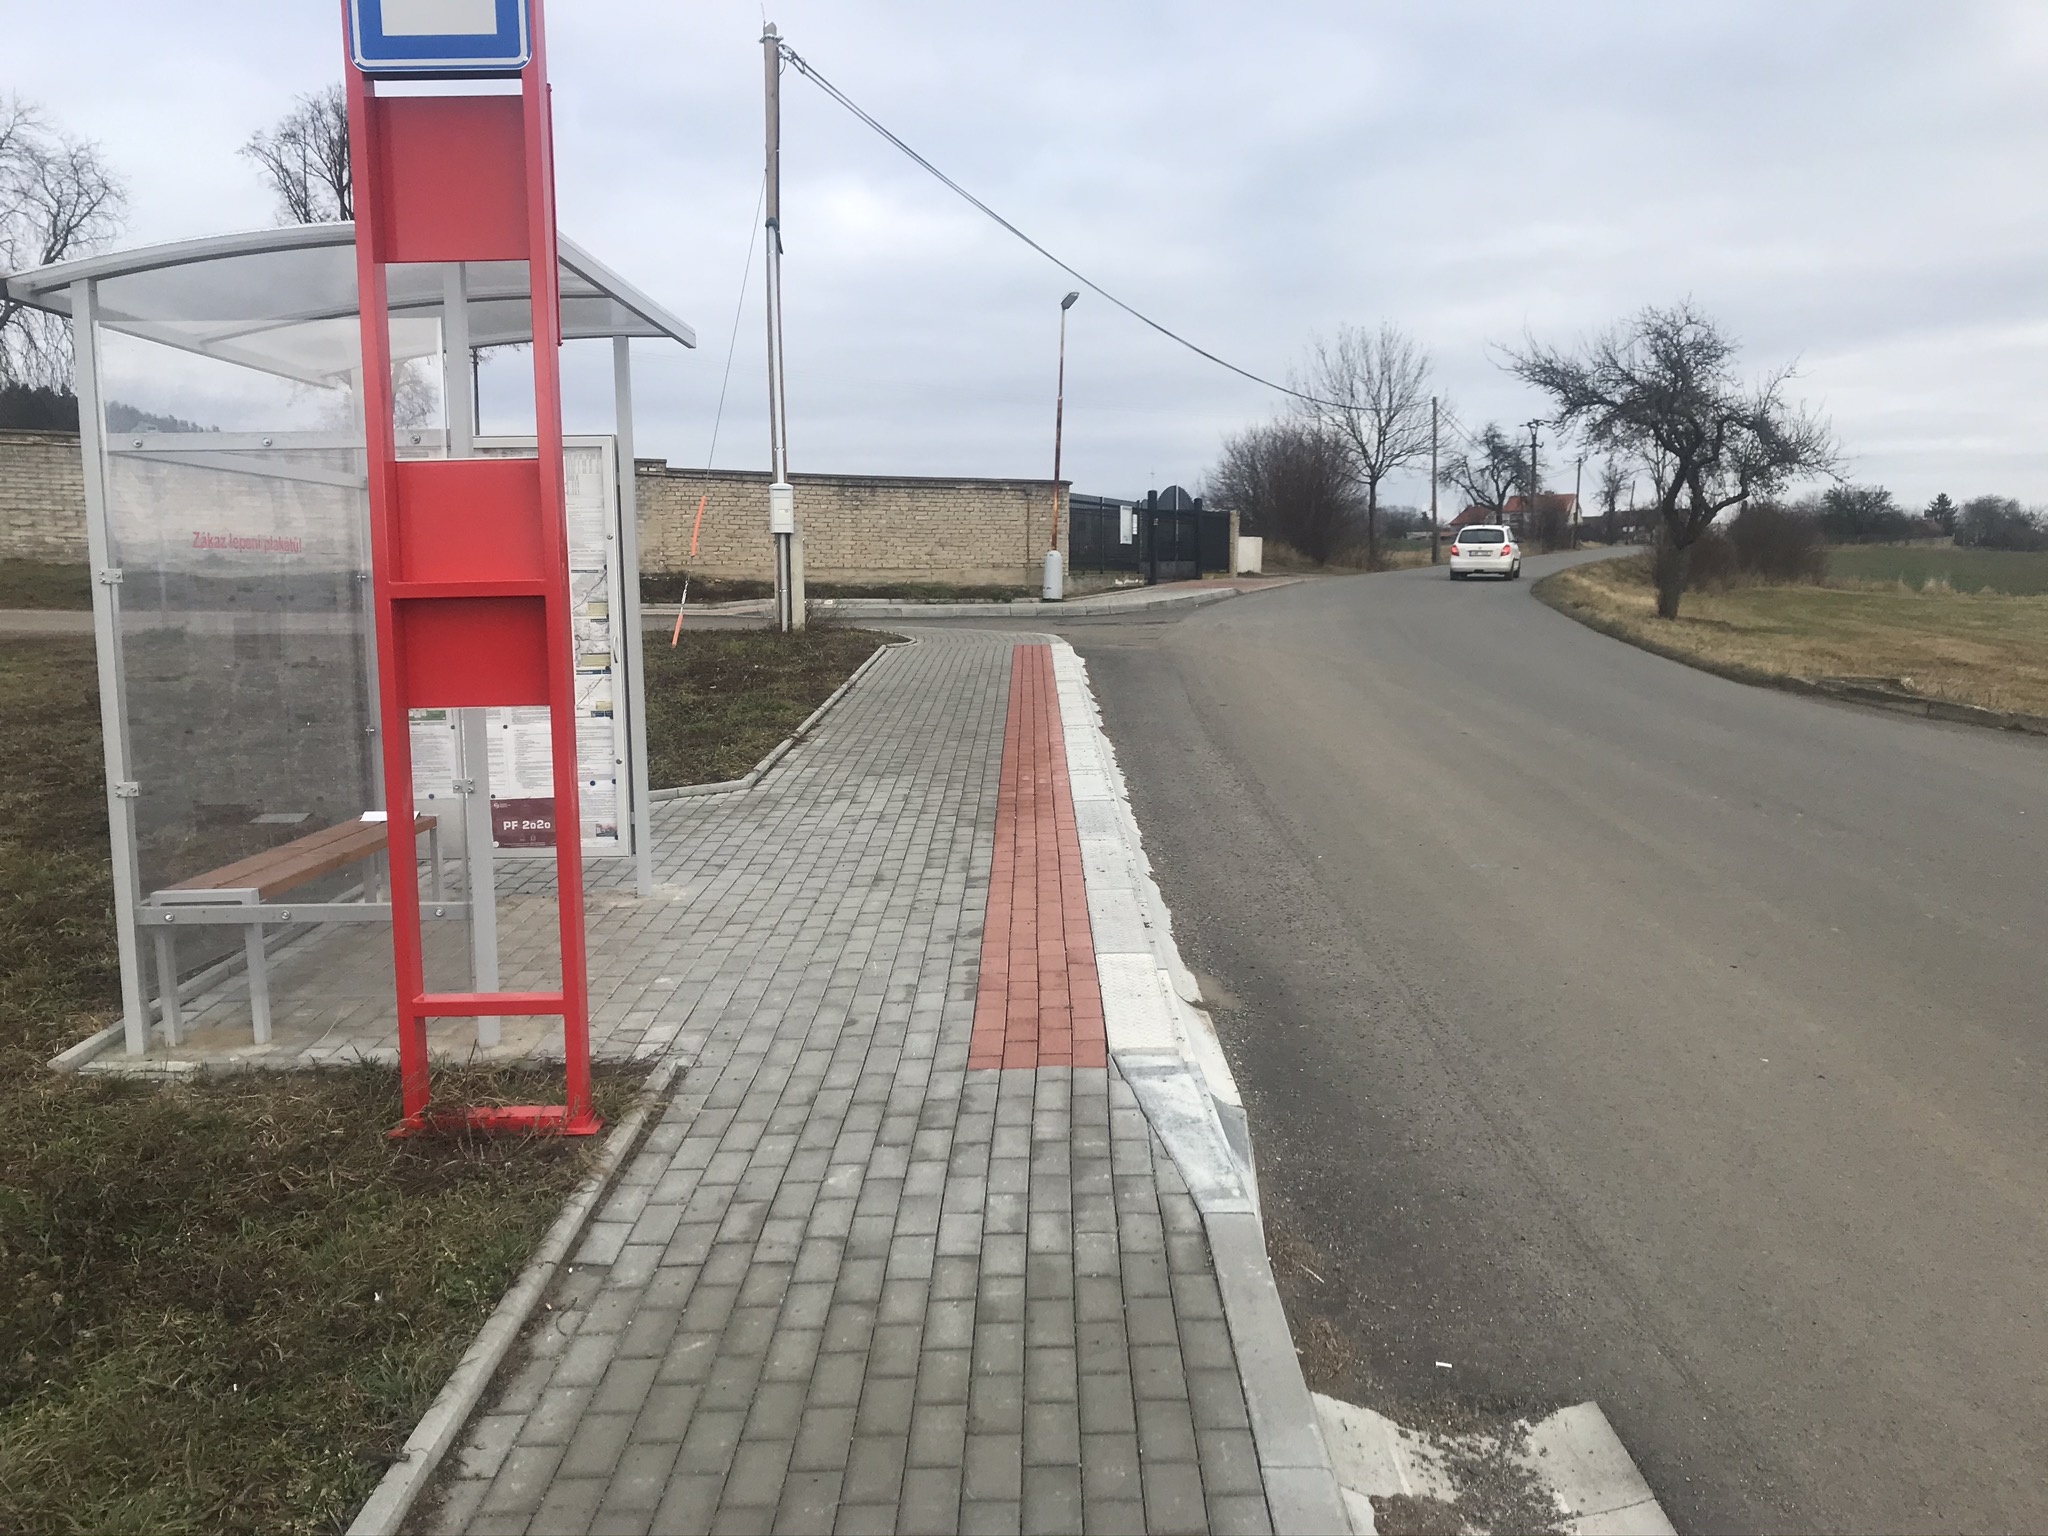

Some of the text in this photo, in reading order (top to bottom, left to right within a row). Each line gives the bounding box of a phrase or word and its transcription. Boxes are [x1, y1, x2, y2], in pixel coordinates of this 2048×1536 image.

[192, 531, 227, 549] Zákaz
[503, 819, 551, 831] PF 2020
